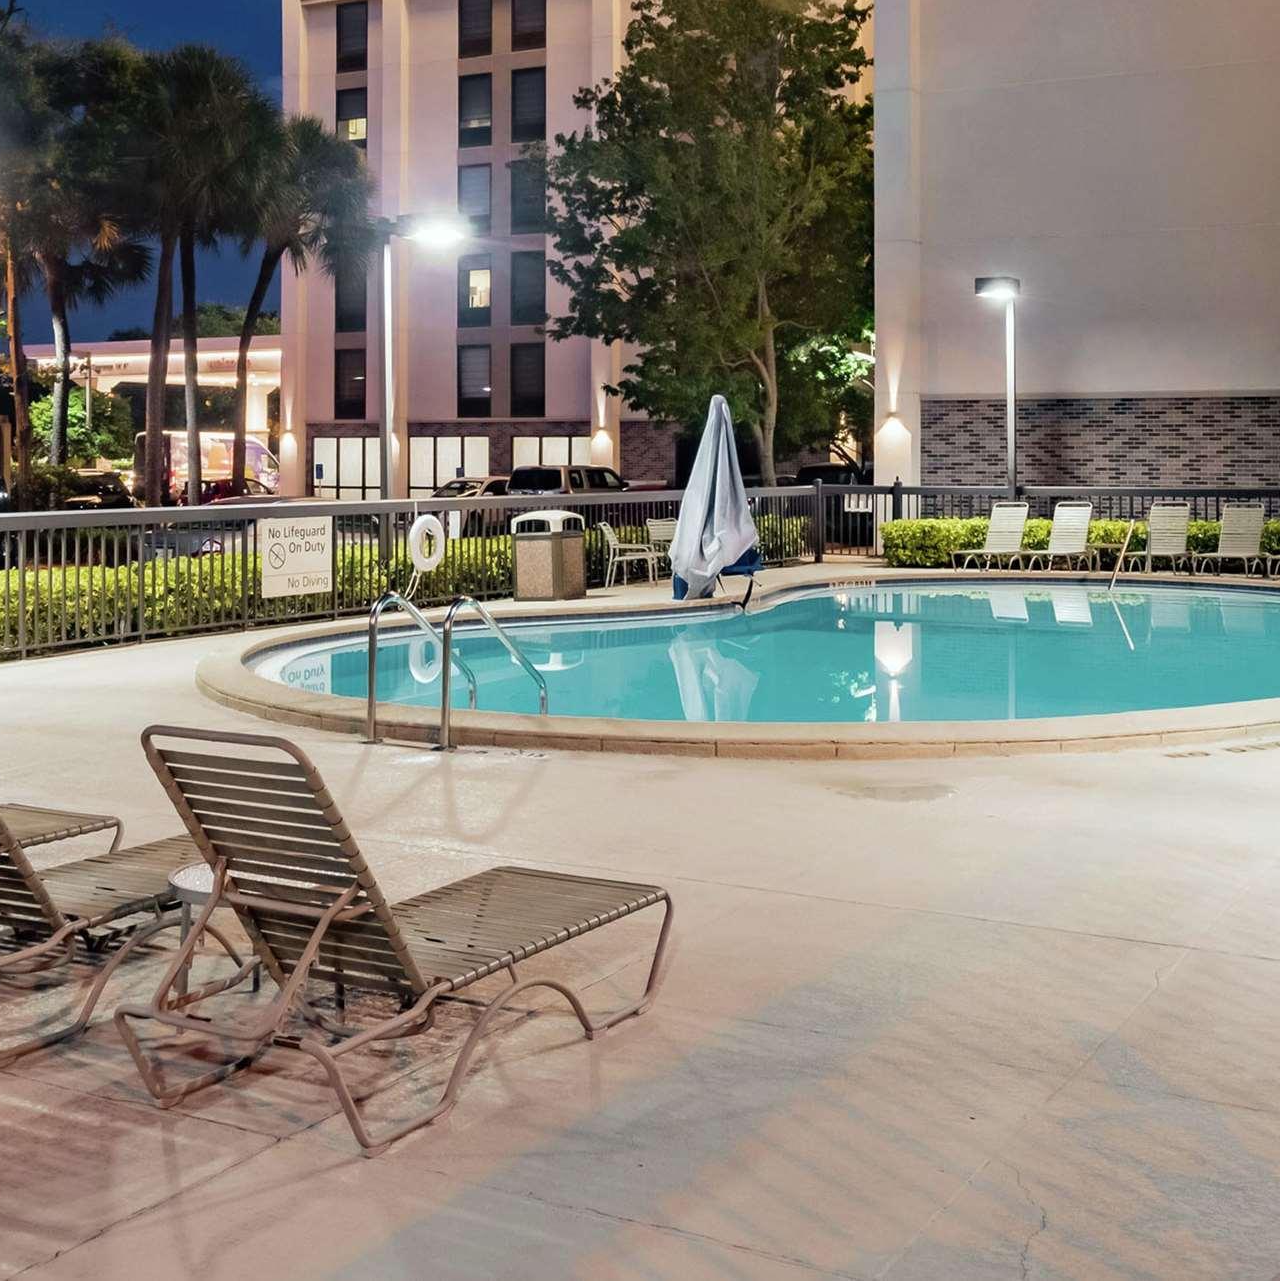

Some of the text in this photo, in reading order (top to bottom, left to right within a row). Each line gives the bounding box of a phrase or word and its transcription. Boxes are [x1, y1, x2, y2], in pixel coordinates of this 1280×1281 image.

[268, 525, 326, 540] No Lifeguard
[289, 540, 326, 554] On Duty
[287, 576, 329, 589] No Diving
